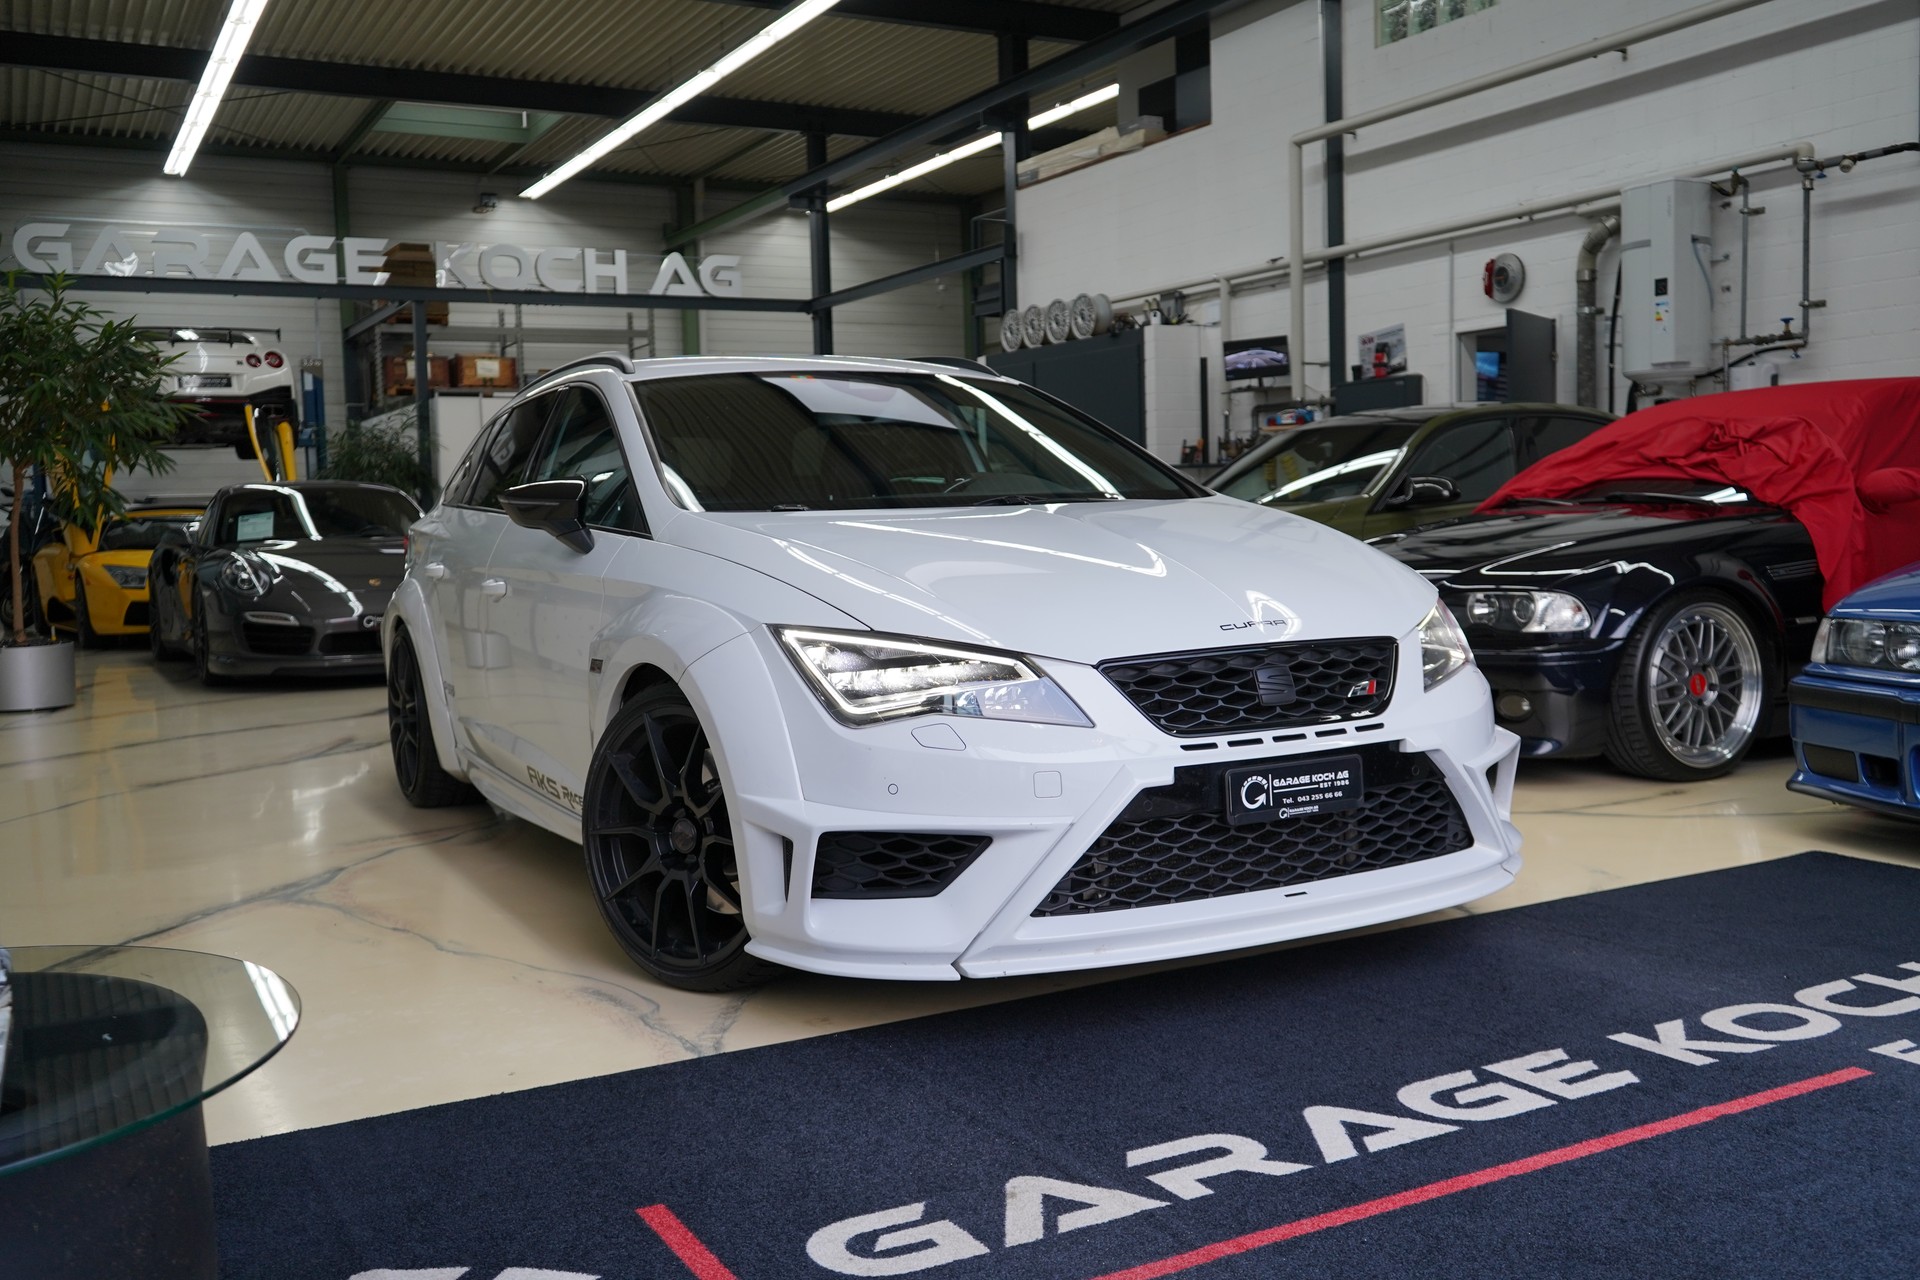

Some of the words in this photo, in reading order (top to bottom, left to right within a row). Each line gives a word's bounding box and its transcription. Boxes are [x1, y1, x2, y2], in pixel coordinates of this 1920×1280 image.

[12, 223, 390, 286] GARAGE
[435, 241, 628, 294] KOCH
[650, 251, 742, 297] AG
[1220, 619, 1287, 631] CUPRA
[1272, 775, 1310, 787] GARAGE
[1312, 772, 1335, 782] KOCH
[1336, 770, 1349, 779] AG
[1333, 779, 1349, 787] 1986
[1311, 793, 1323, 801] 255
[805, 1048, 1640, 1277] GARAGE
